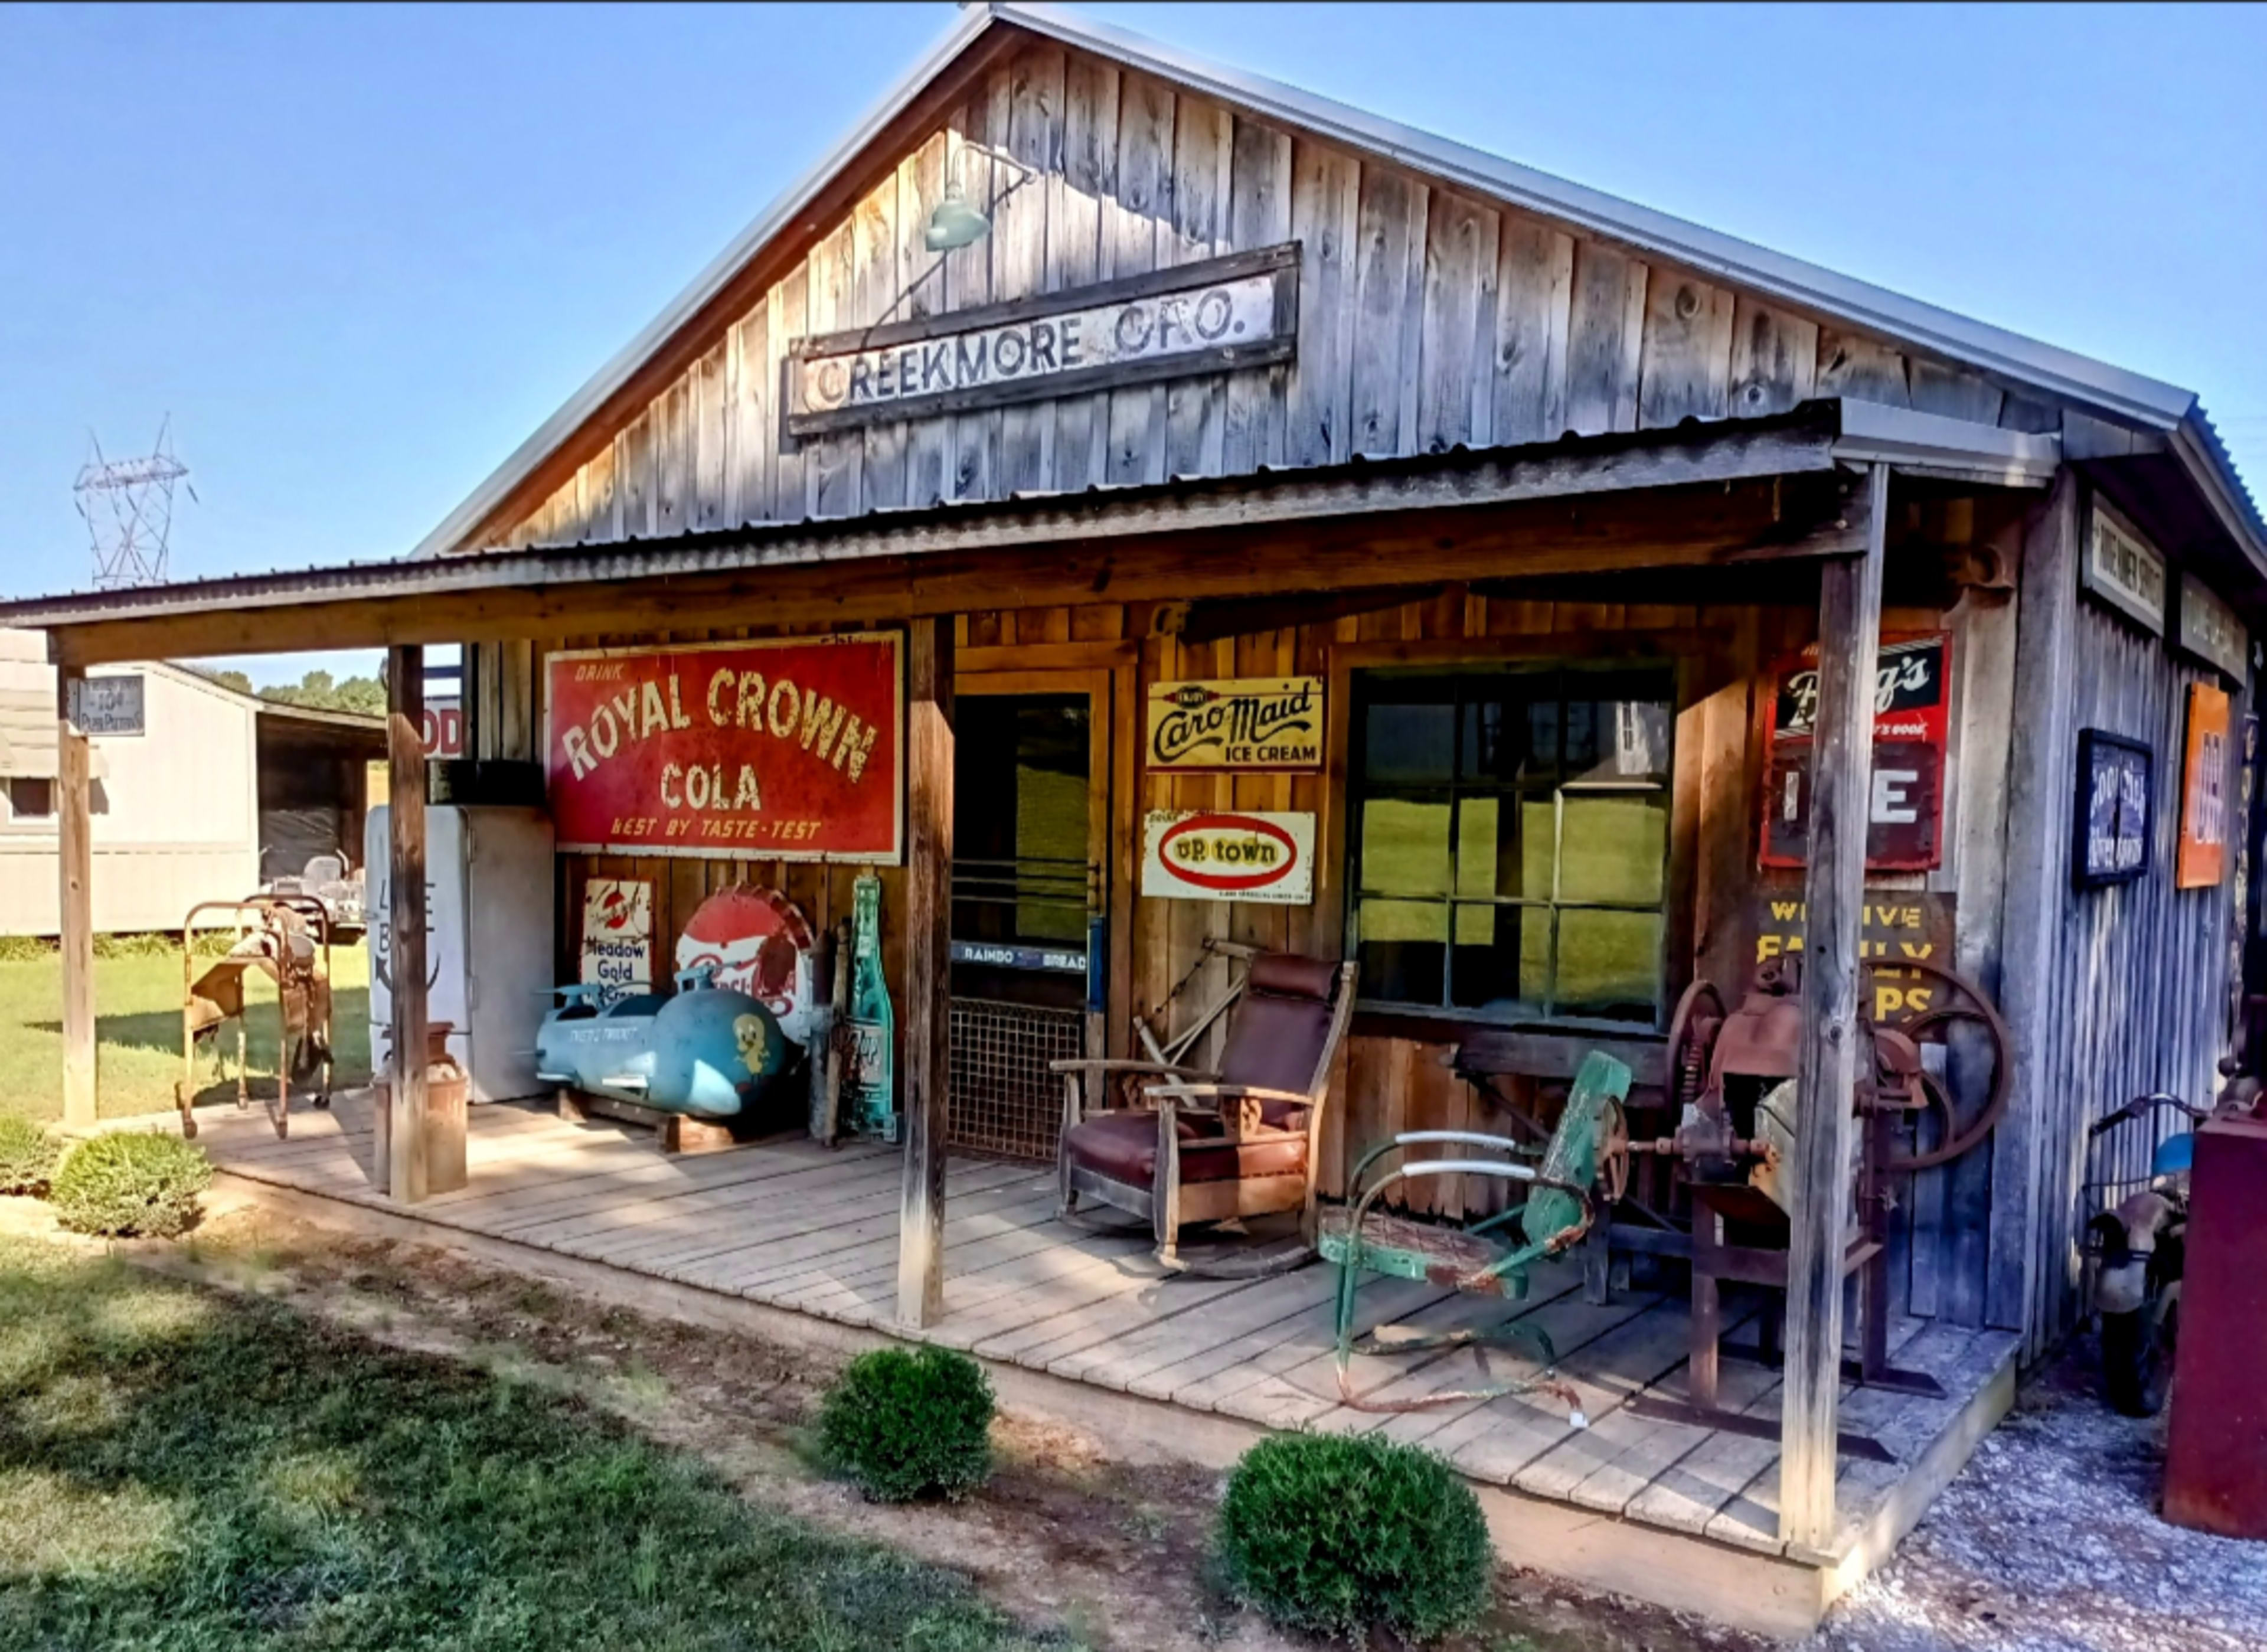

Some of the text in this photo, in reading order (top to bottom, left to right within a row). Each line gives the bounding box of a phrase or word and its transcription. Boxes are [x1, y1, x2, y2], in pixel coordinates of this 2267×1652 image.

[818, 318, 1082, 403] CREEKMORE
[574, 664, 623, 682] DRINK
[1227, 681, 1312, 743] Maid
[562, 667, 878, 783] ROYAL CROWN
[1226, 745, 1317, 762] ICE CREAM
[660, 763, 761, 811] COLA
[1784, 770, 1918, 823] IE
[611, 817, 657, 835] BEST
[665, 820, 691, 836] BY
[1863, 905, 1922, 929] IVE
[598, 959, 633, 982] Gold
[1043, 954, 1086, 971] BREAD
